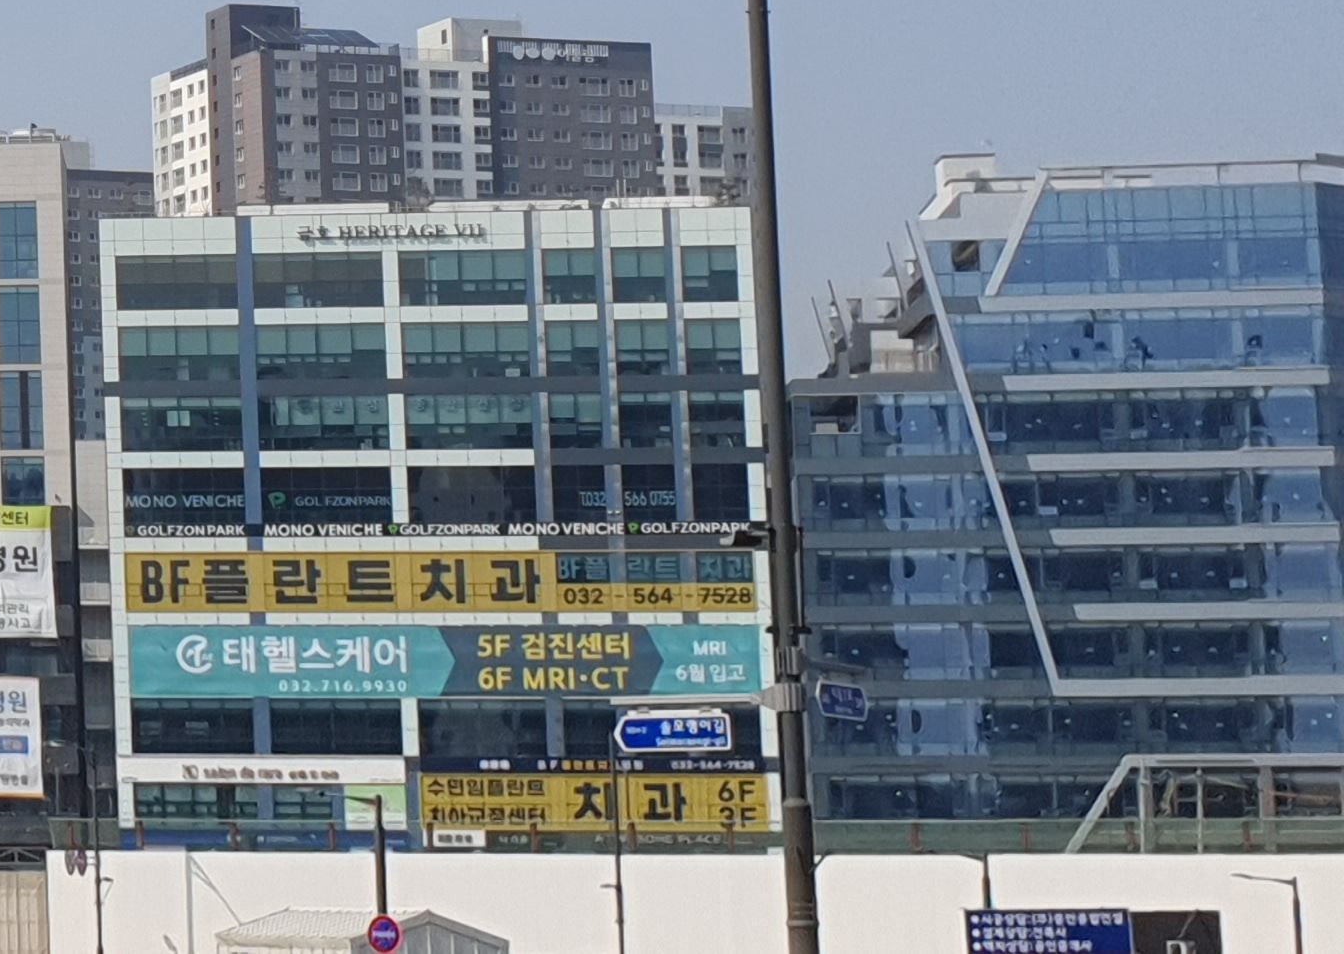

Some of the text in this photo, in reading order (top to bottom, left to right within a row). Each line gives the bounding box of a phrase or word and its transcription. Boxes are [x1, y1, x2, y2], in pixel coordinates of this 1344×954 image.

[338, 224, 446, 239] HERITAGE
[126, 495, 245, 508] MONO VENICHE
[624, 491, 647, 507] 566
[264, 523, 383, 537] MONO VENICHE
[508, 521, 625, 536] MONO VENICHE
[700, 587, 752, 604] 7528
[223, 635, 407, 673] 태헬스케어
[477, 633, 631, 660] 5F 검진센터
[694, 641, 727, 656] MRI
[478, 667, 512, 690] 6F
[675, 664, 746, 682] 6월 입고
[718, 780, 755, 802] 6F
